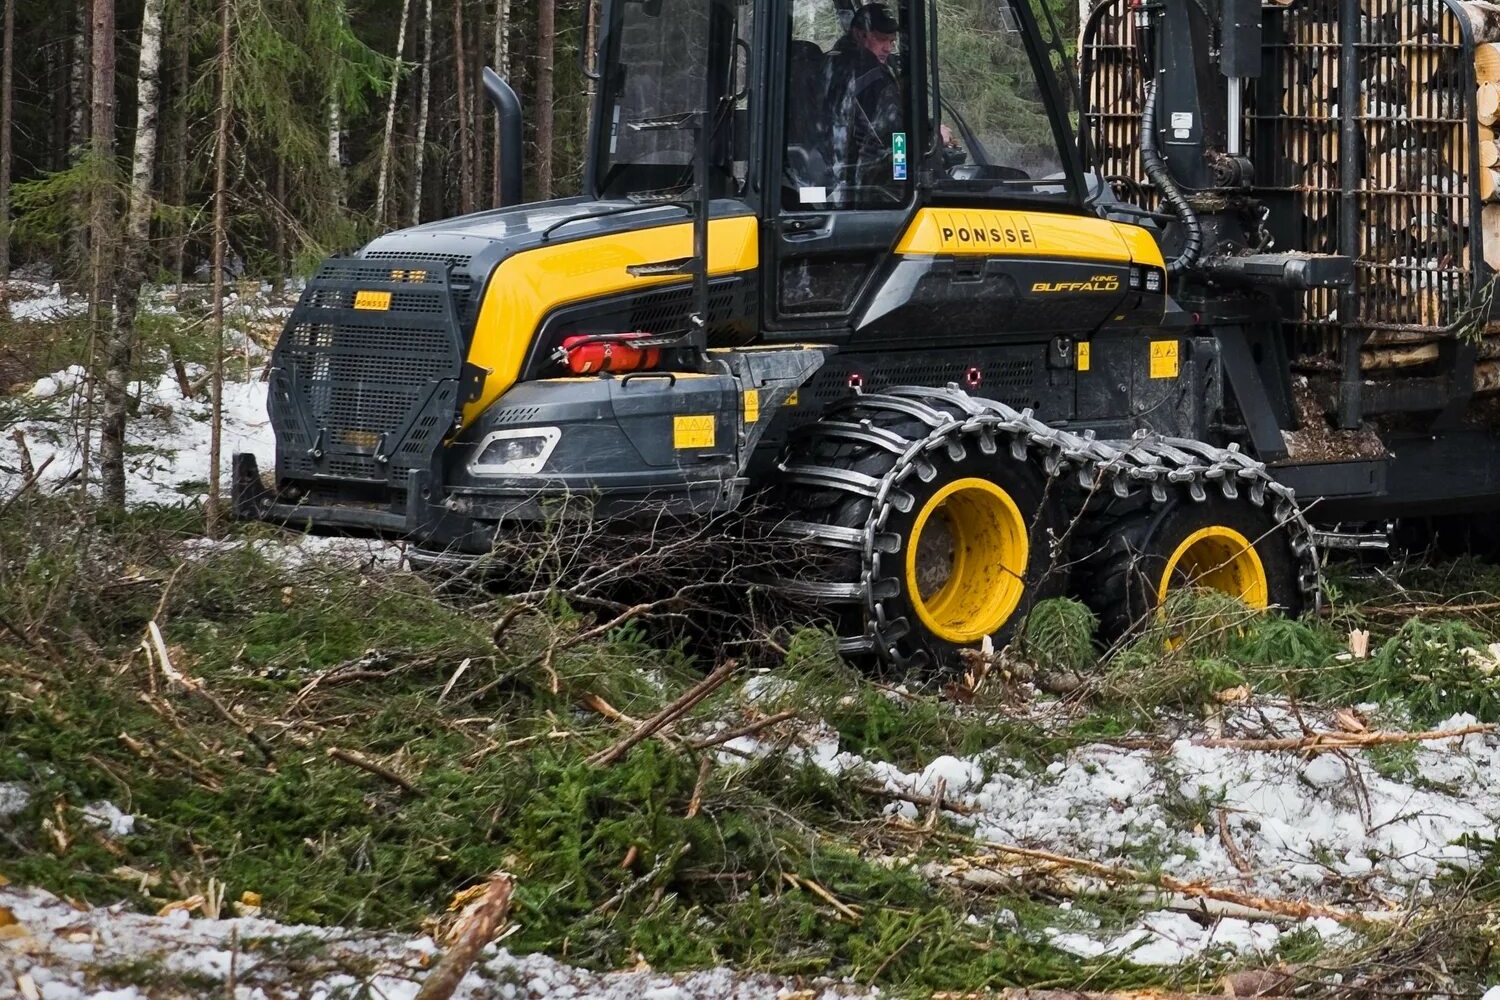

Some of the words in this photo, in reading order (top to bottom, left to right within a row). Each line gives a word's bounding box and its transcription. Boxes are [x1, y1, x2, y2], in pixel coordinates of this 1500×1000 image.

[942, 227, 1032, 243] PONSSE
[1032, 282, 1119, 291] BUFFALO
[356, 300, 388, 308] PONSSE
